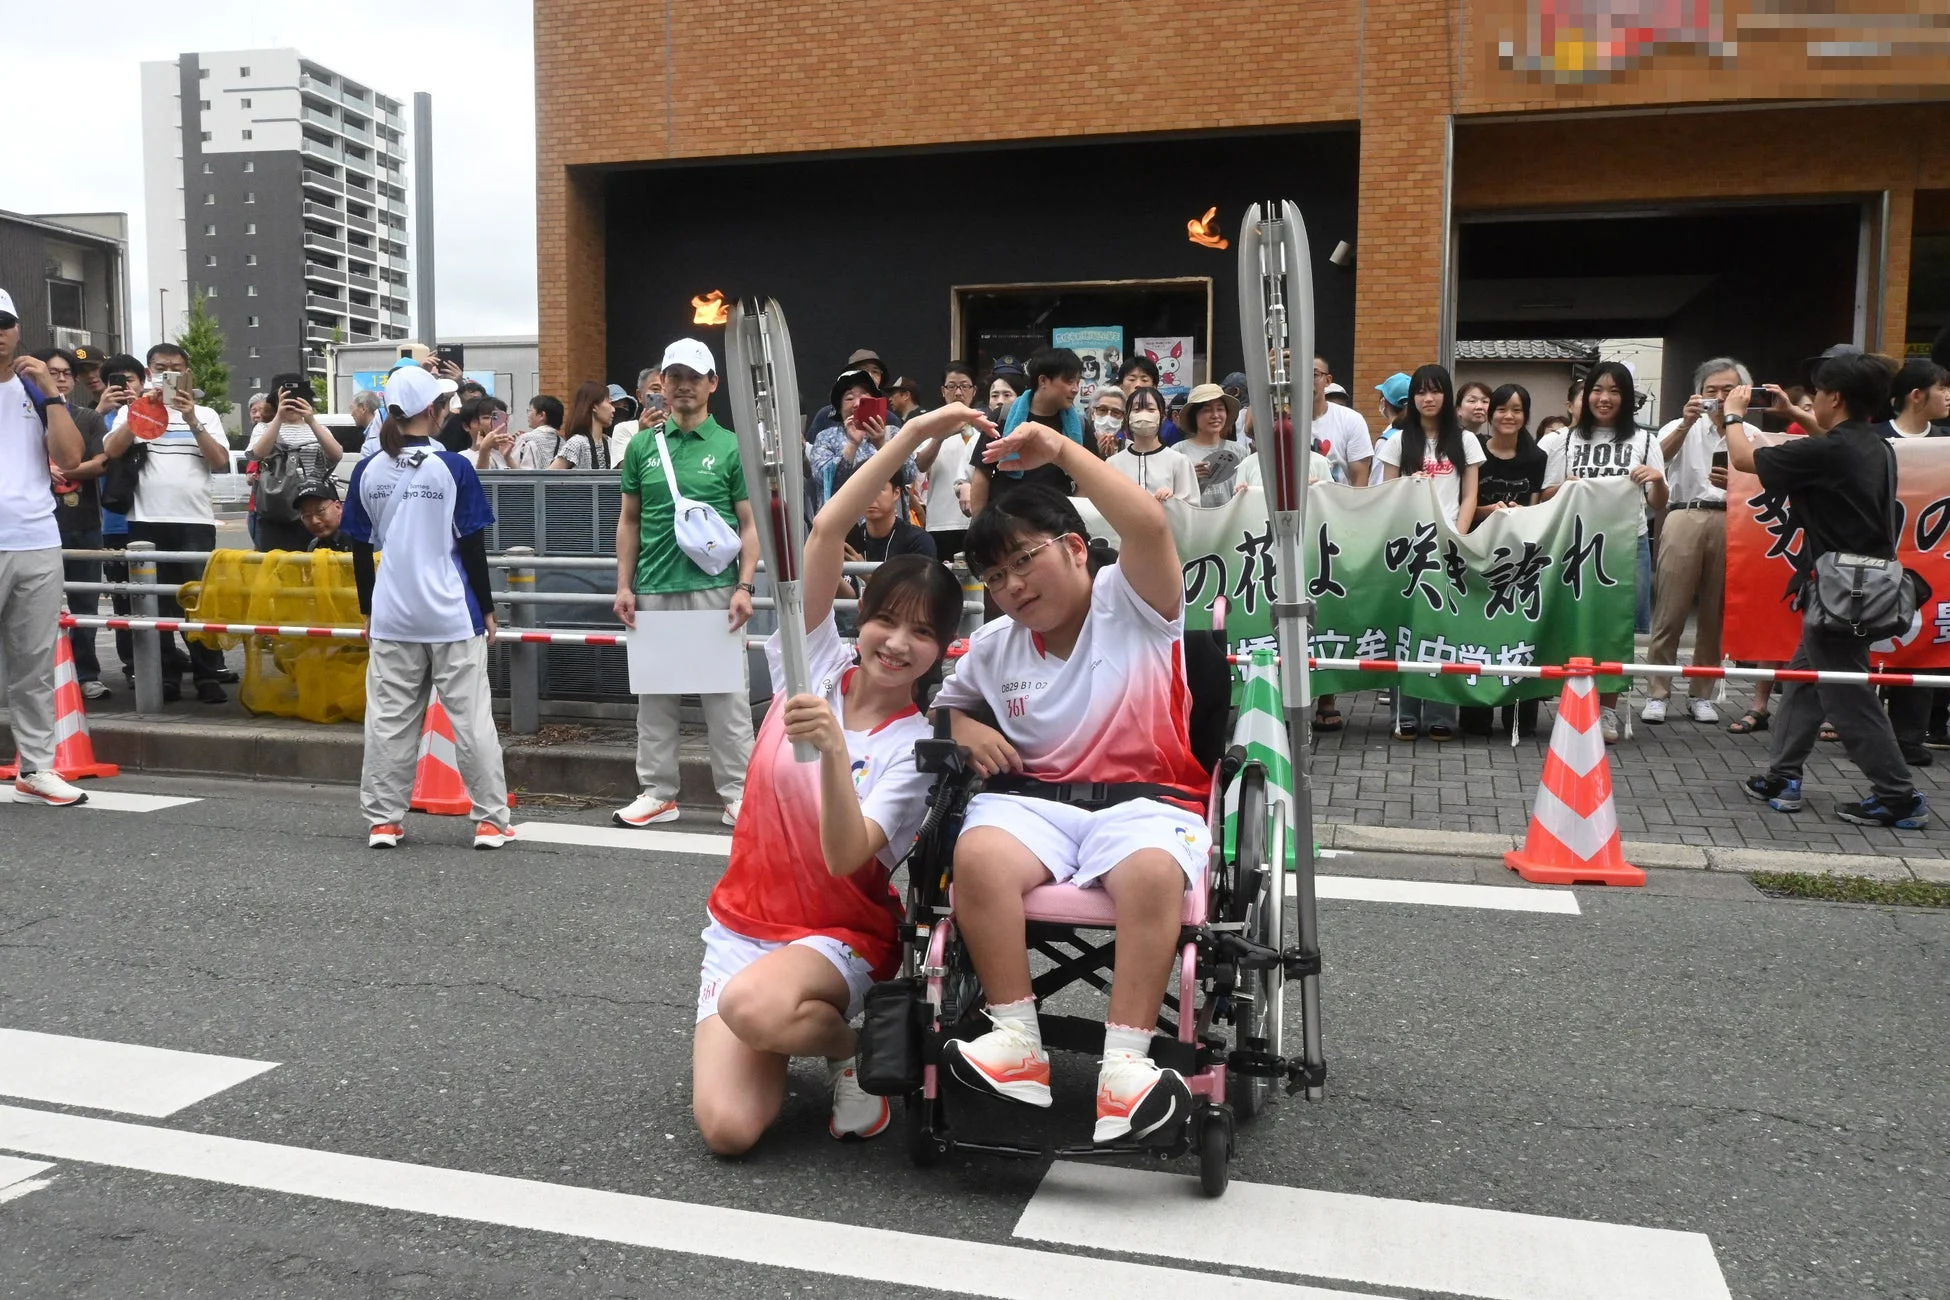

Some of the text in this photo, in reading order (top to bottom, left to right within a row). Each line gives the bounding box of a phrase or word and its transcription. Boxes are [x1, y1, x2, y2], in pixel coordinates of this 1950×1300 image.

[1572, 443, 1633, 468] HOU
[421, 490, 444, 500] 2026
[1001, 681, 1048, 693] 0829 B1 02
